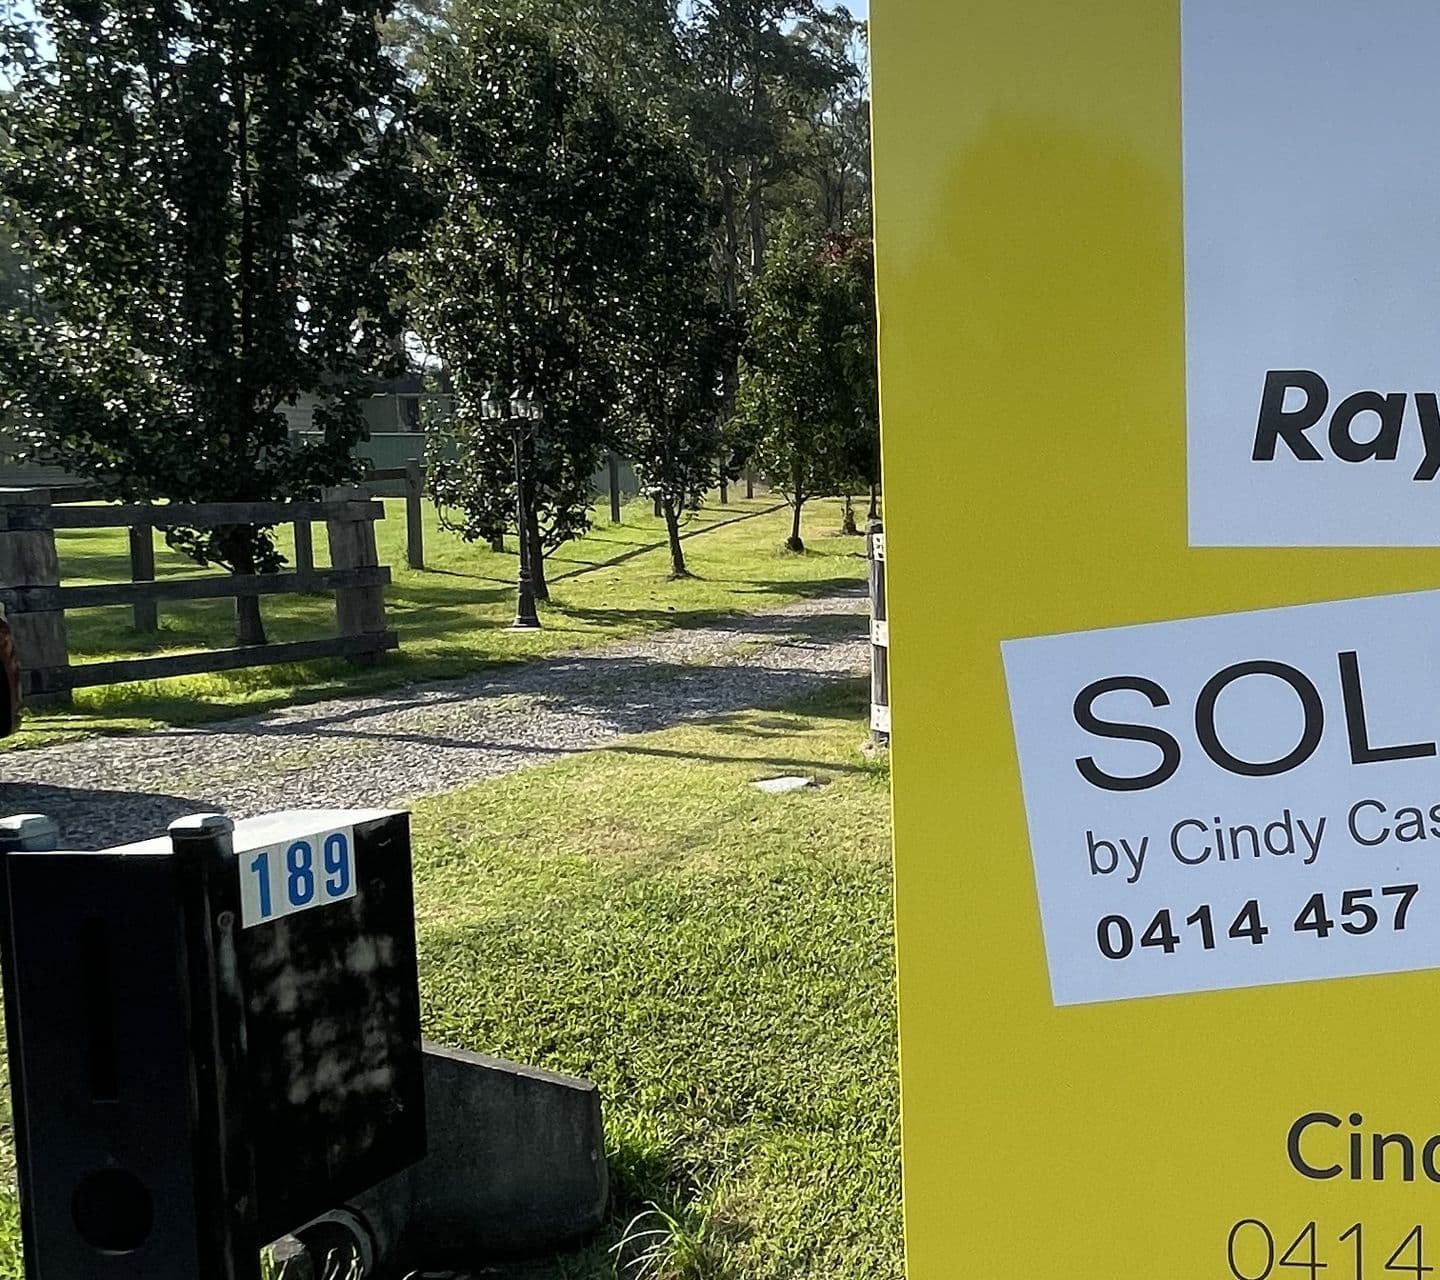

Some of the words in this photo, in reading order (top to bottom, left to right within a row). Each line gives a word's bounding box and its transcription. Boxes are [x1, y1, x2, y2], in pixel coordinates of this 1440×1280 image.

[250, 833, 351, 918] 189
[1086, 830, 1149, 884] by
[1170, 808, 1327, 865] Cindy
[1096, 899, 1269, 960] 0414
[1293, 883, 1419, 939] 457
